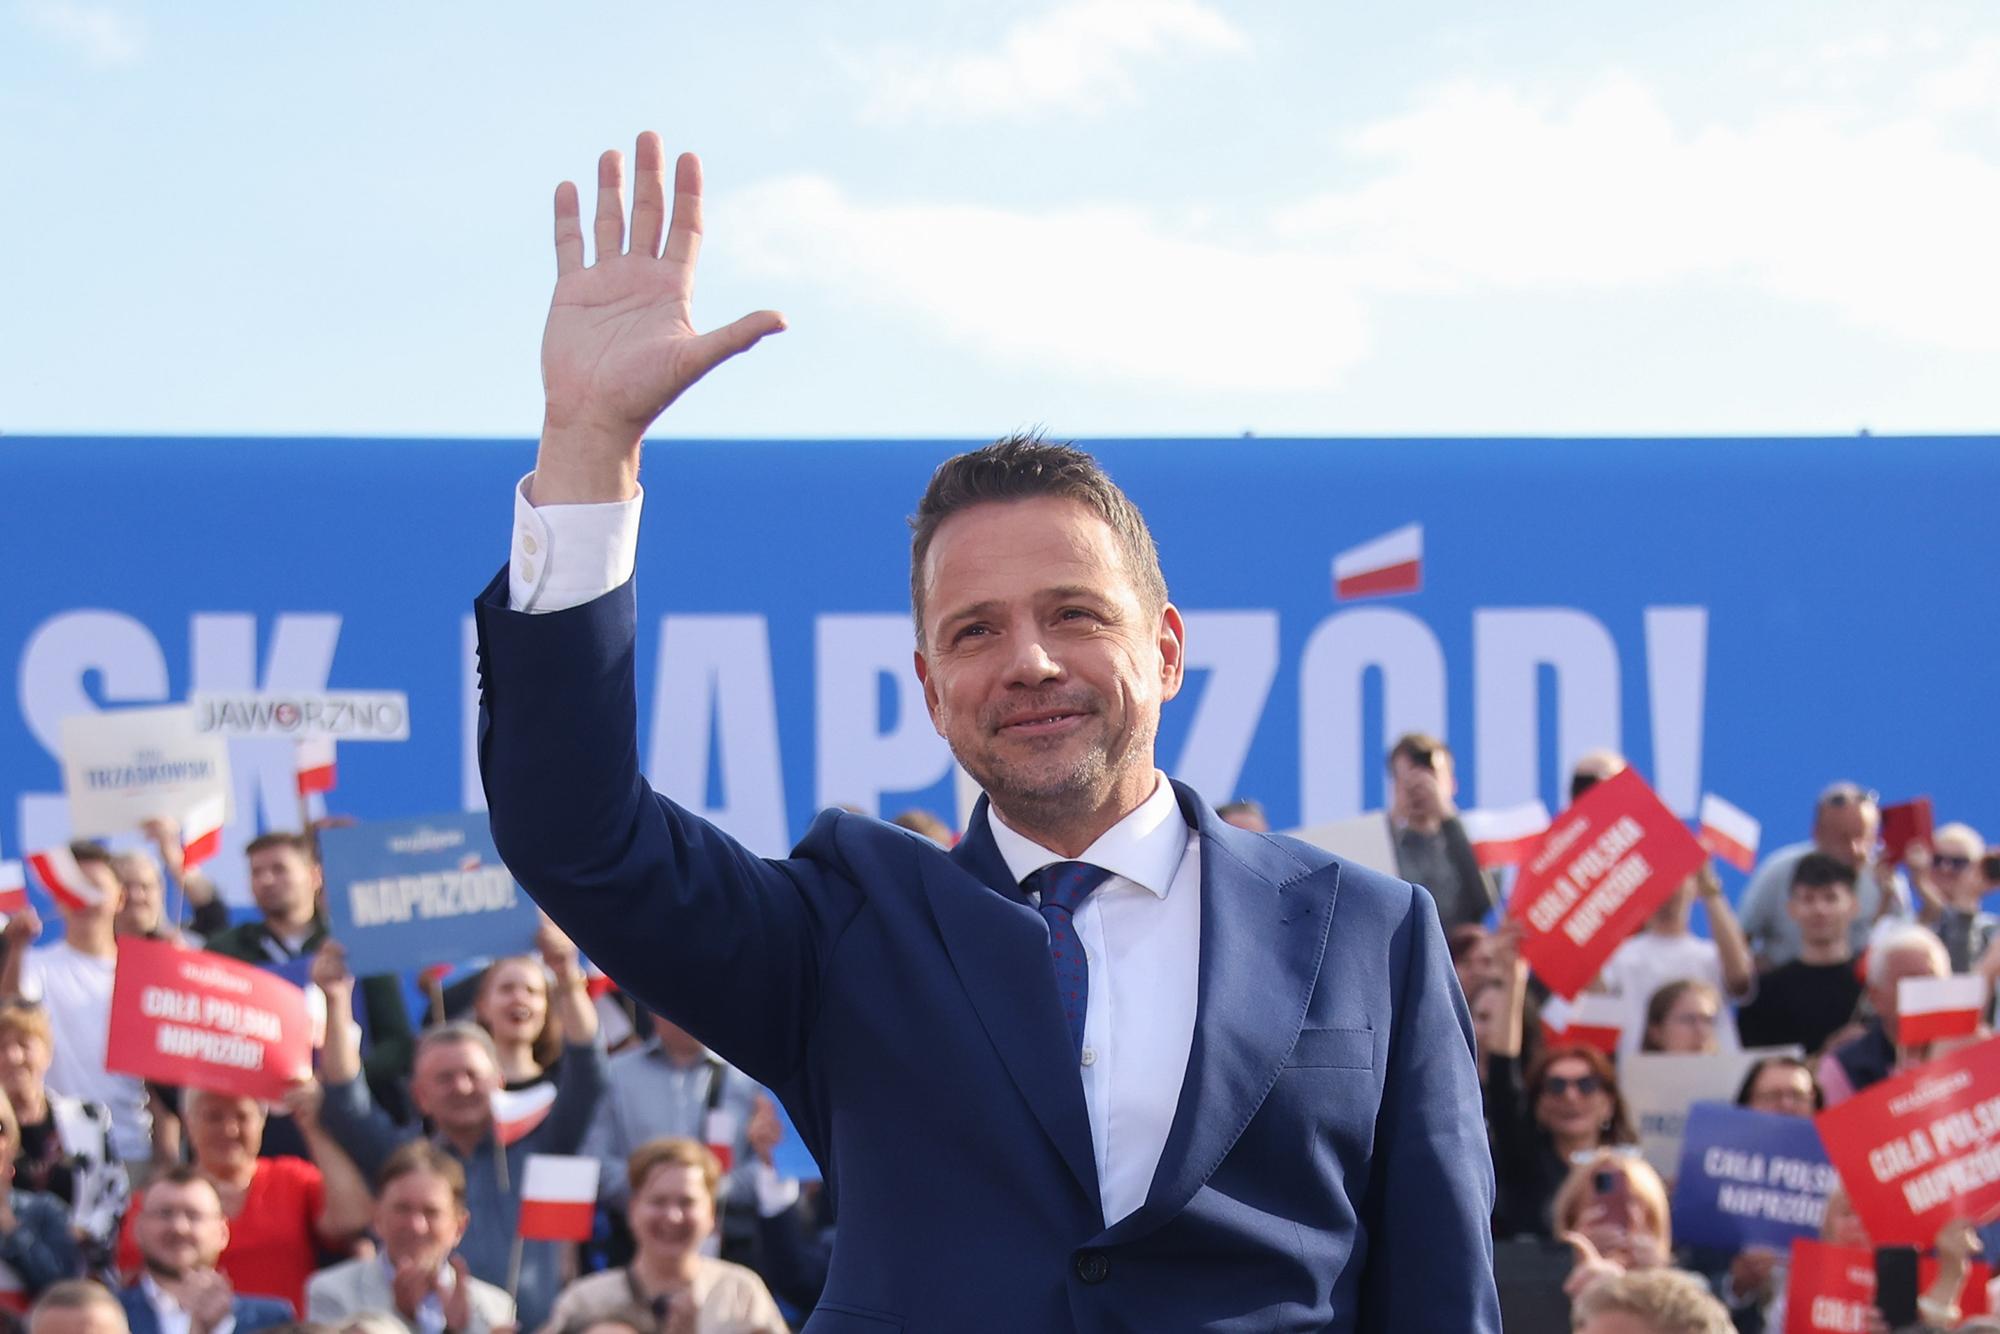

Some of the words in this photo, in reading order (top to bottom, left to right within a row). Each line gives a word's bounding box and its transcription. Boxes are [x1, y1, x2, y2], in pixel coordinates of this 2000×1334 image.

[202, 700, 402, 734] JAWORZNO
[1567, 814, 1646, 891] POLSKA
[350, 853, 518, 928] NAPRZÓD!
[141, 985, 201, 1023] CAŁA
[203, 996, 283, 1043] POLSKA
[156, 1023, 265, 1071] NAPRZÓD!
